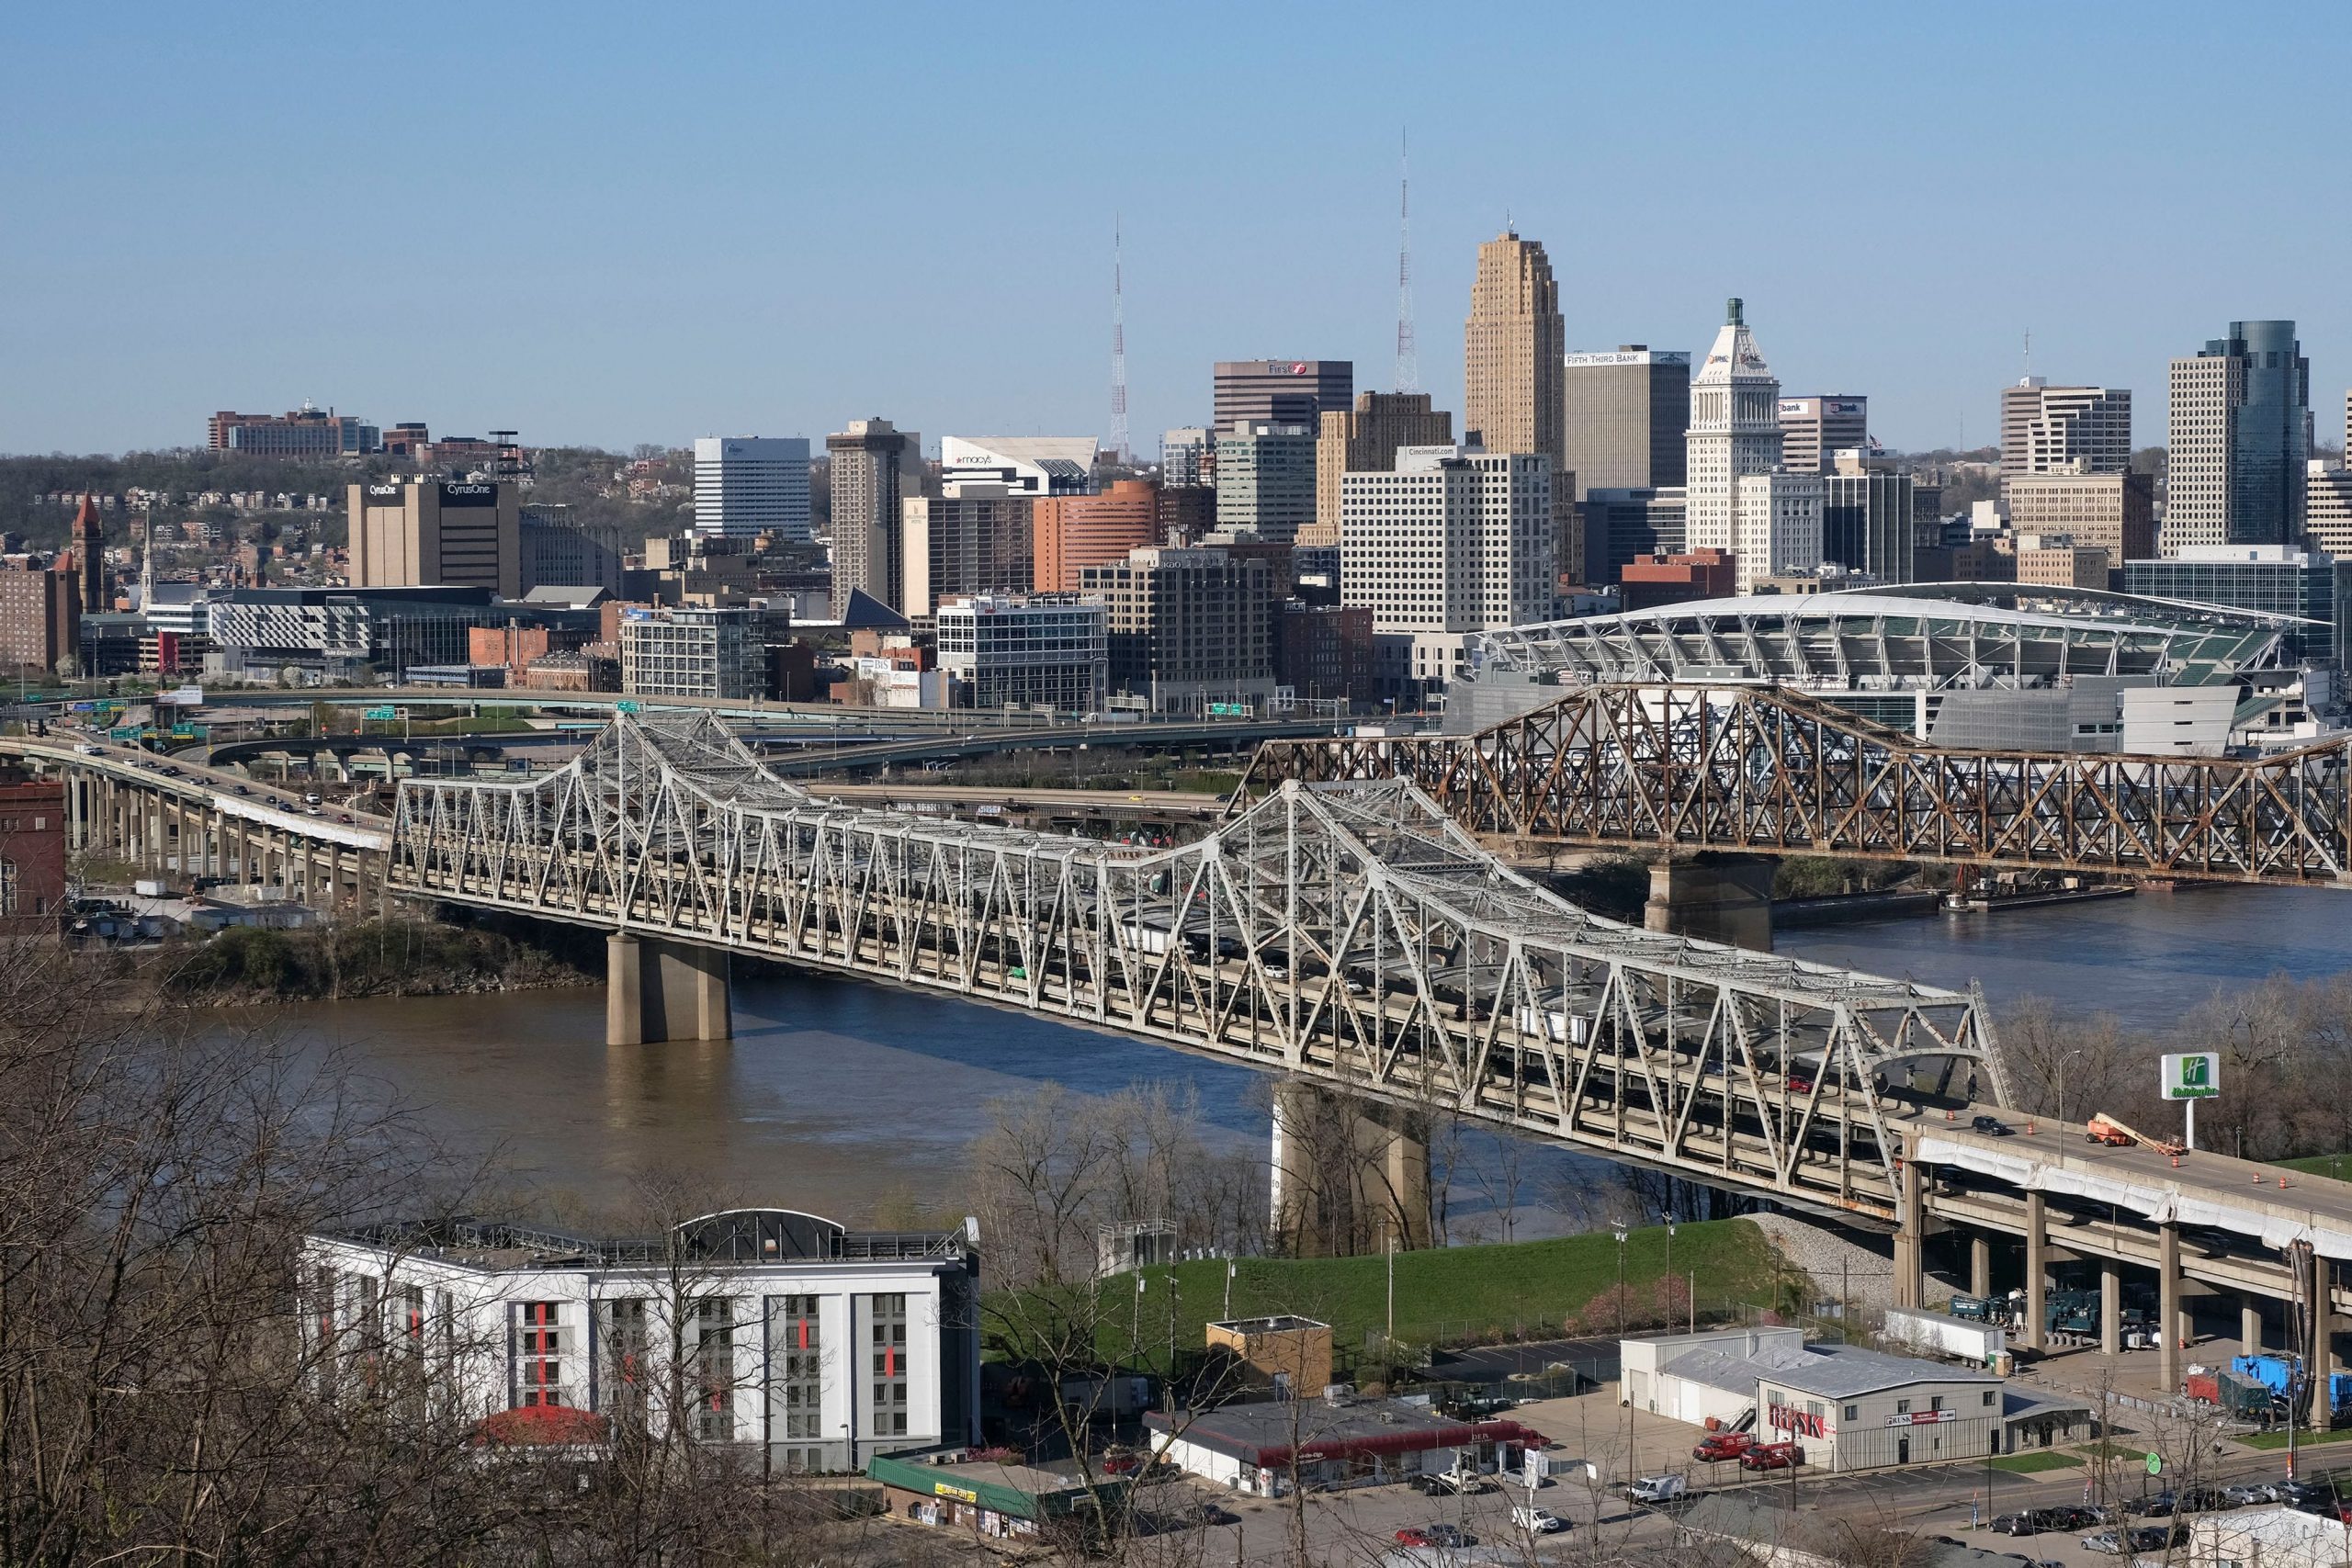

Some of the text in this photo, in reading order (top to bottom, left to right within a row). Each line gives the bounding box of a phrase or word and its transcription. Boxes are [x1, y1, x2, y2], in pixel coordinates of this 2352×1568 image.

[1567, 354, 1638, 364] FIFTH THIRD BANK
[1269, 364, 1292, 374] First
[369, 485, 396, 496] CyrusOne
[447, 484, 491, 495] CyrusOne
[2172, 1086, 2219, 1098] Holiday Inn
[1272, 1179, 1280, 1189] 50
